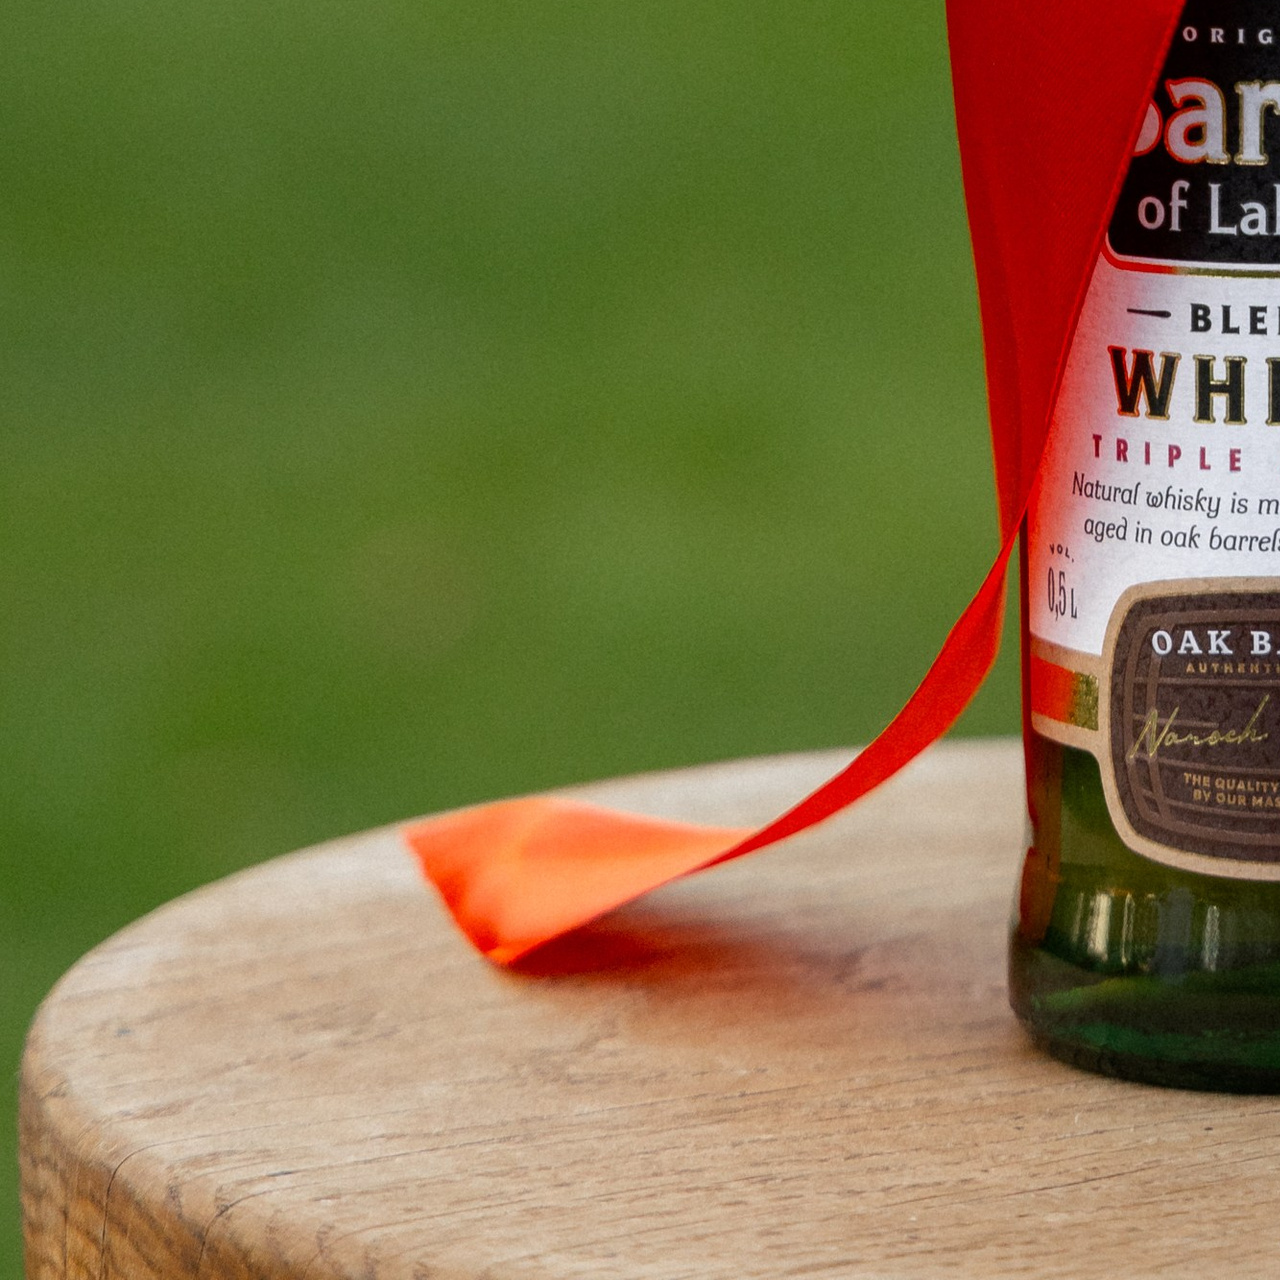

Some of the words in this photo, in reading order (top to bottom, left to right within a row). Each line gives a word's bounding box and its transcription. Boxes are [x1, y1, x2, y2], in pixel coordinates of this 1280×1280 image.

[1137, 179, 1191, 231] of
[1092, 433, 1242, 472] TRIPLE
[1071, 471, 1141, 506] Natural
[1145, 485, 1222, 519] whisky
[1230, 492, 1249, 515] is
[1083, 516, 1128, 543] aged
[1134, 520, 1153, 544] in
[1160, 524, 1200, 550] oak
[1151, 629, 1233, 656] OAK
[1183, 772, 1211, 788] THE
[1214, 777, 1280, 794] QUALITY
[1192, 789, 1212, 802] BY
[1216, 792, 1247, 806] OUR
